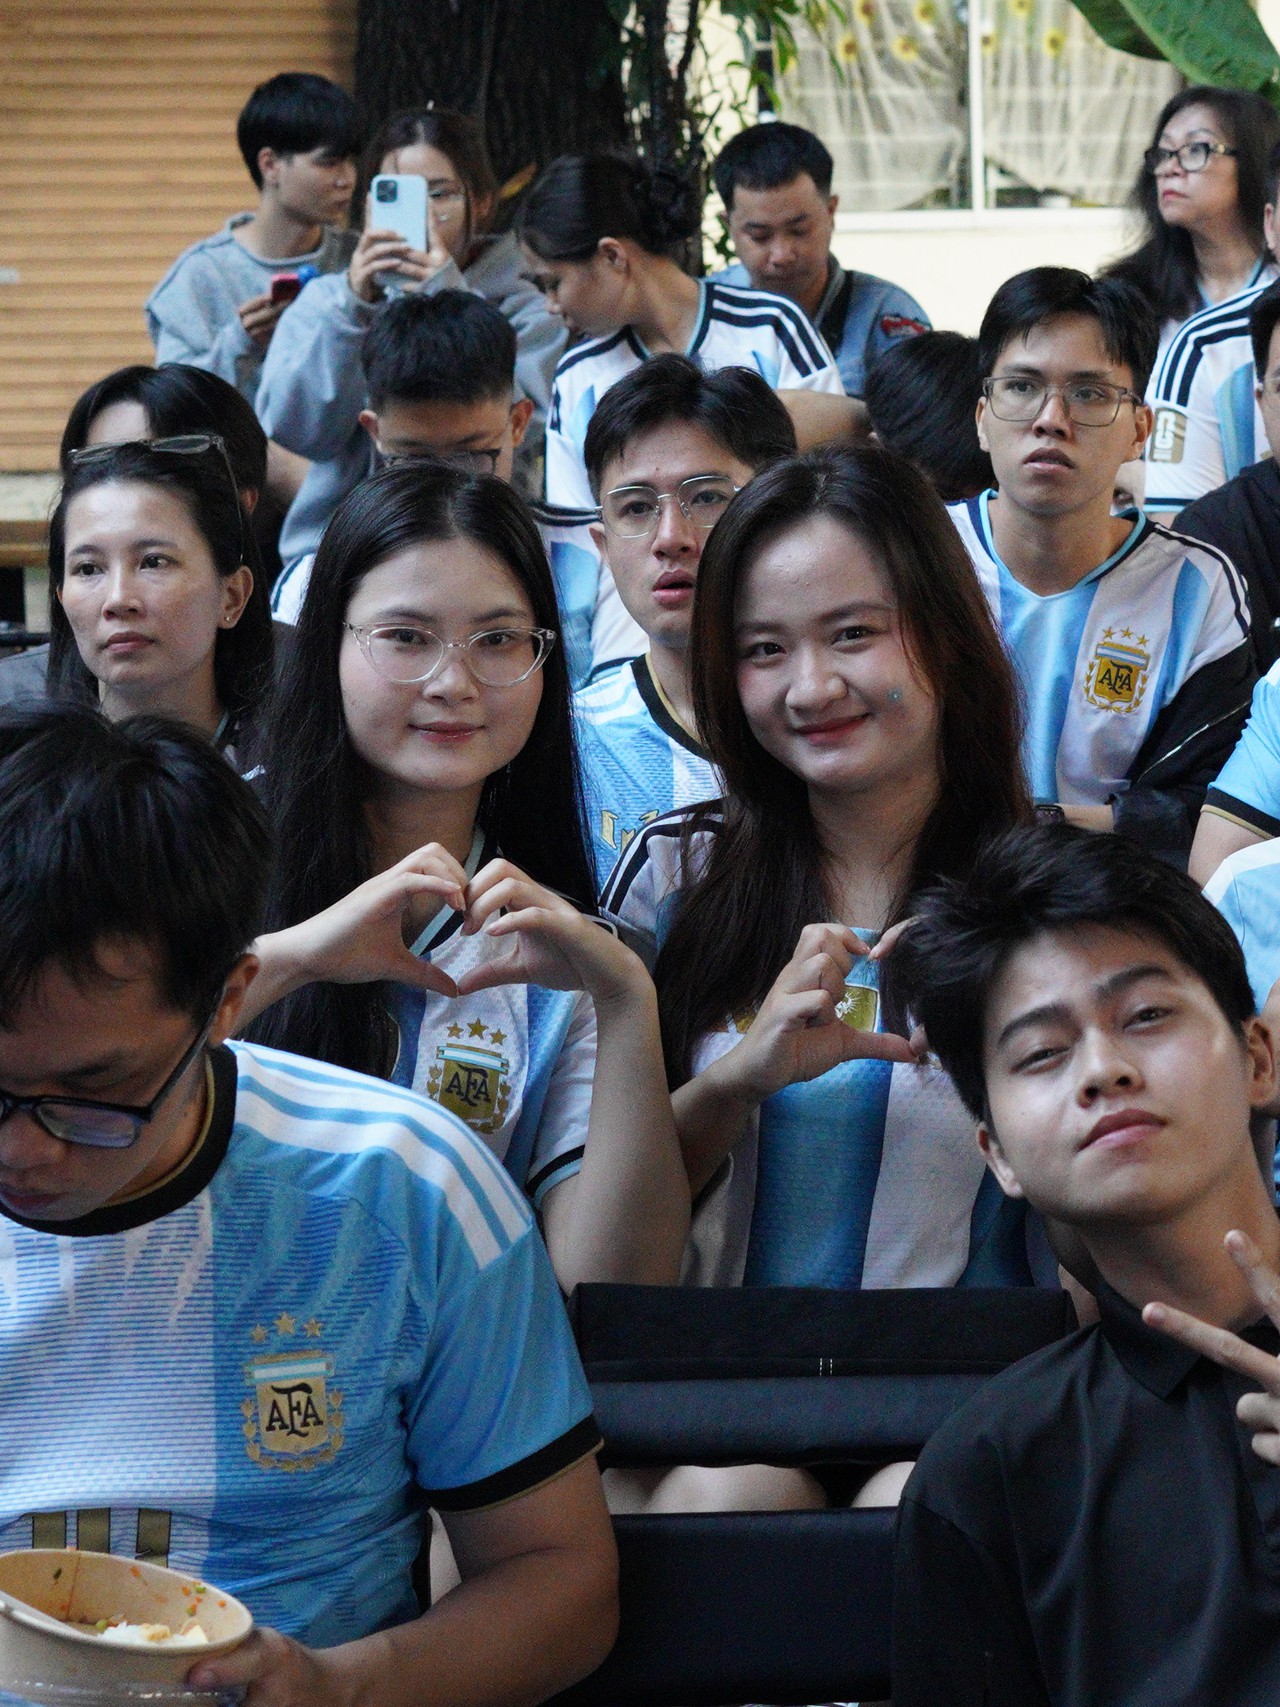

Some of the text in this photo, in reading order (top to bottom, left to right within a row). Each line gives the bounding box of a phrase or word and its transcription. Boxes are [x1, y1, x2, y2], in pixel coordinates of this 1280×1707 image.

[1099, 660, 1132, 695] AFA
[445, 1063, 491, 1107] AFA
[266, 1382, 323, 1438] AFA
